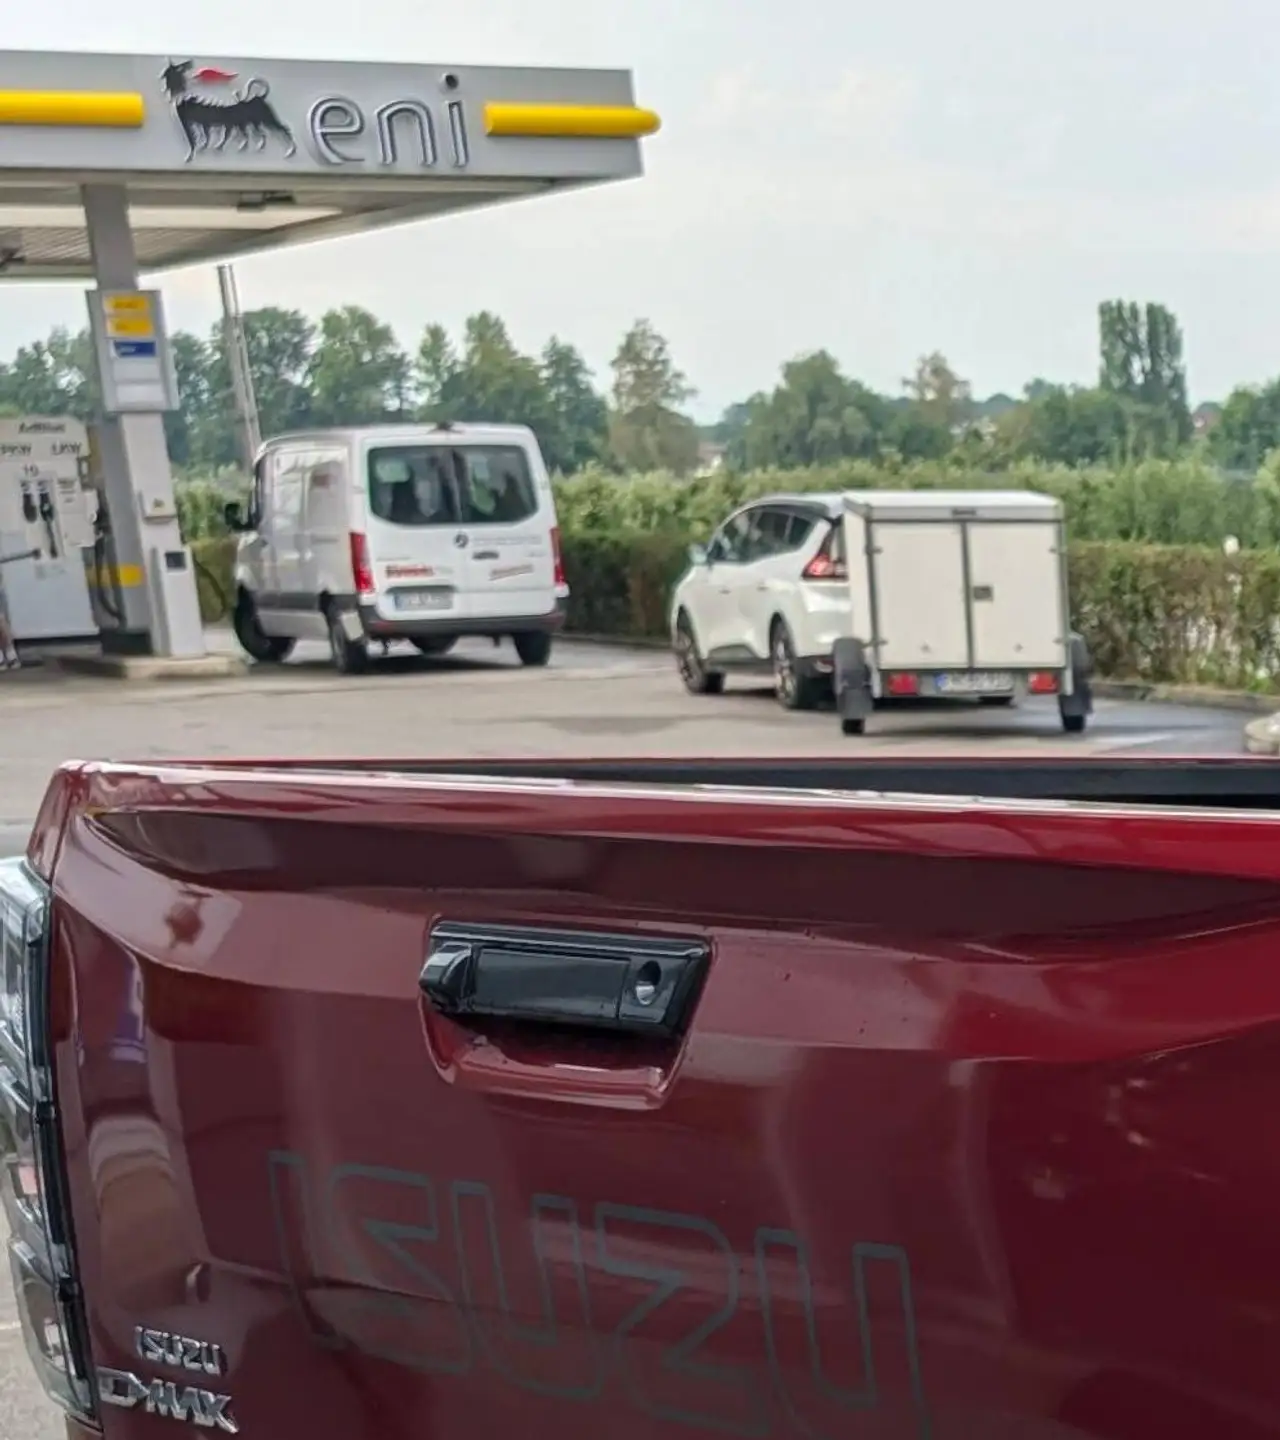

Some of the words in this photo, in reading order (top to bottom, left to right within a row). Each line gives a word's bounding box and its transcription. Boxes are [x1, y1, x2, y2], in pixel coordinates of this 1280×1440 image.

[307, 72, 469, 168] eni
[135, 1326, 221, 1377] ISUZU
[97, 1366, 239, 1434] D-MAX
